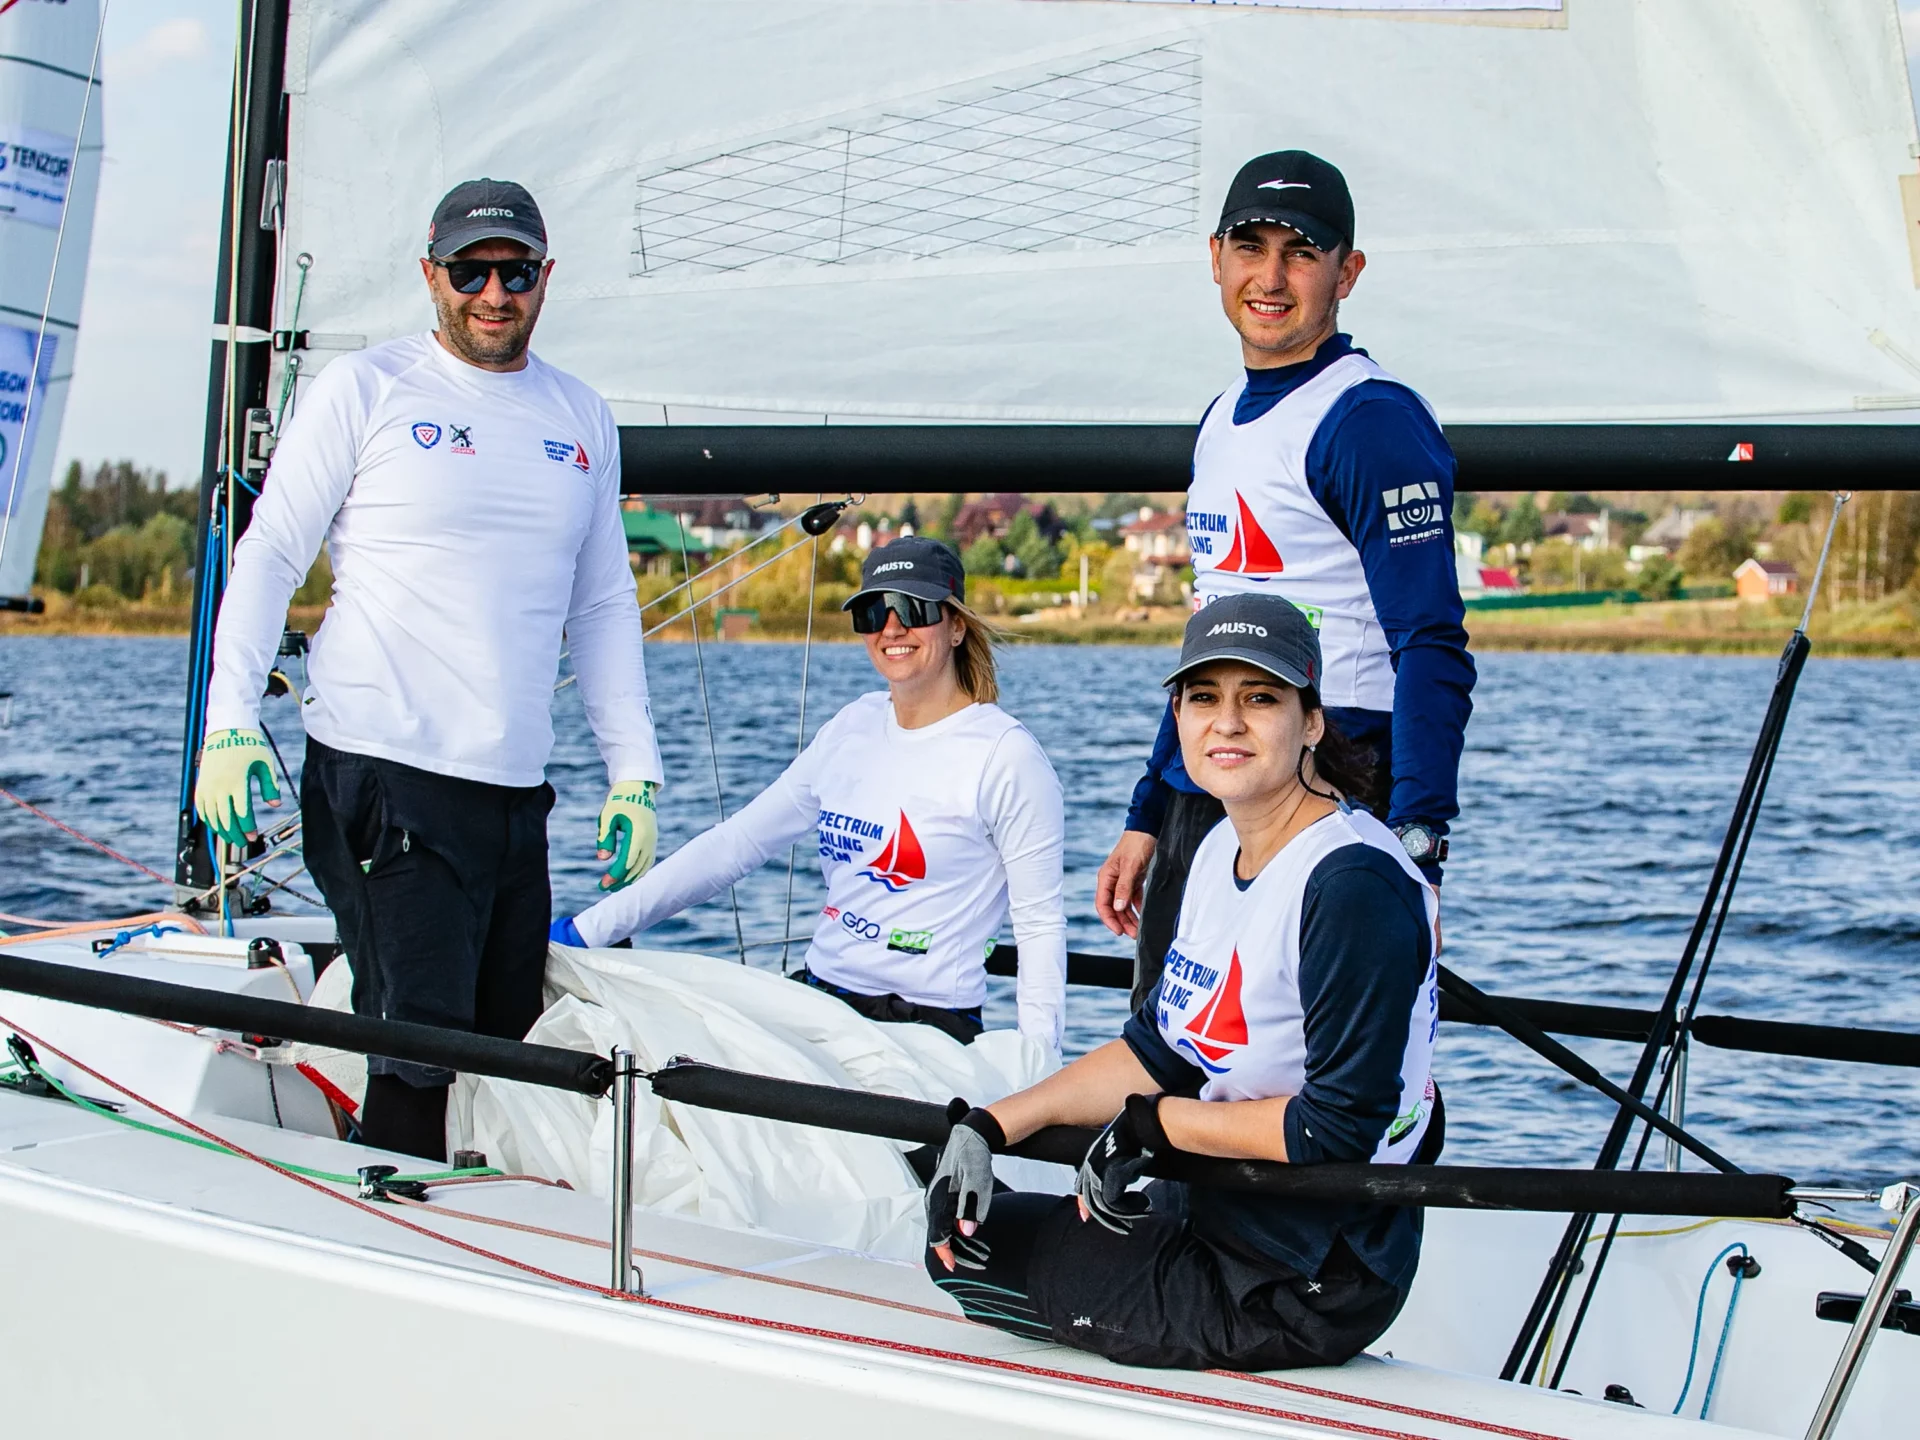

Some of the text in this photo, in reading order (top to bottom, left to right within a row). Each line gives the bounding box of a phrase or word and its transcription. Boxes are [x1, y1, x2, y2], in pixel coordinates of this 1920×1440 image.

[10, 144, 69, 177] TENZOR
[466, 207, 514, 218] MUSTO
[543, 439, 575, 451] SPECTRUM
[545, 446, 570, 457] SAILING
[547, 453, 564, 462] TEAM
[872, 561, 914, 576] MUSTO
[1205, 621, 1268, 638] MUSTO
[817, 829, 864, 853] AILING
[1073, 1316, 1092, 1327] zhik
